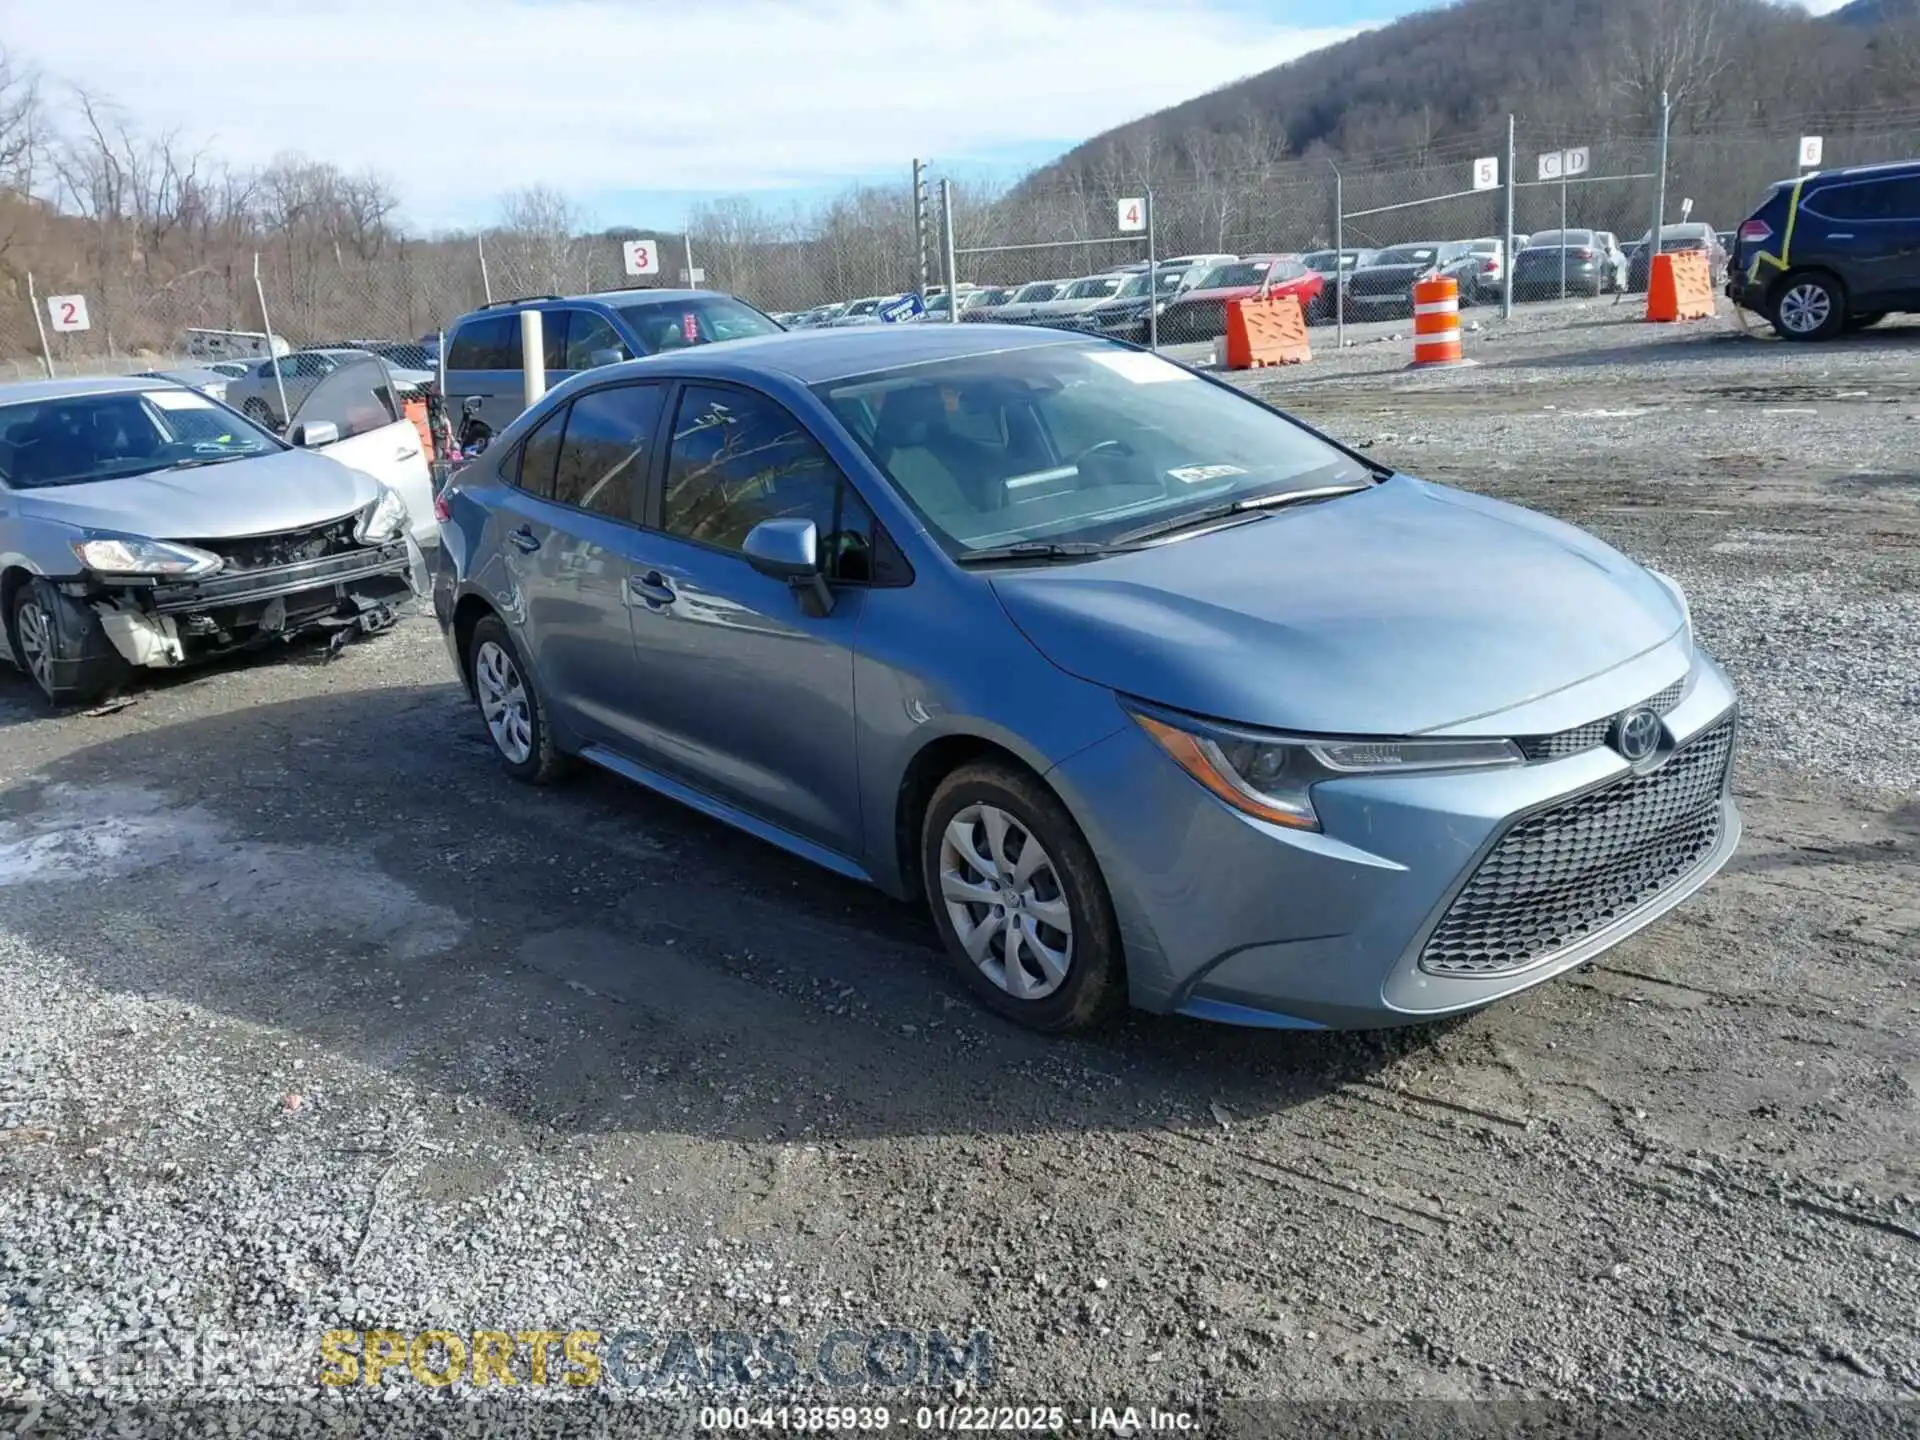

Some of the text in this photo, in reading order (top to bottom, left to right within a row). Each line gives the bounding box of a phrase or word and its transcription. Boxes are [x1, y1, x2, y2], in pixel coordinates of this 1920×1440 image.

[1481, 164, 1491, 182] 5
[1544, 153, 1584, 174] C D
[1126, 204, 1139, 224] 4
[634, 247, 648, 268] 3
[60, 303, 79, 324] 2
